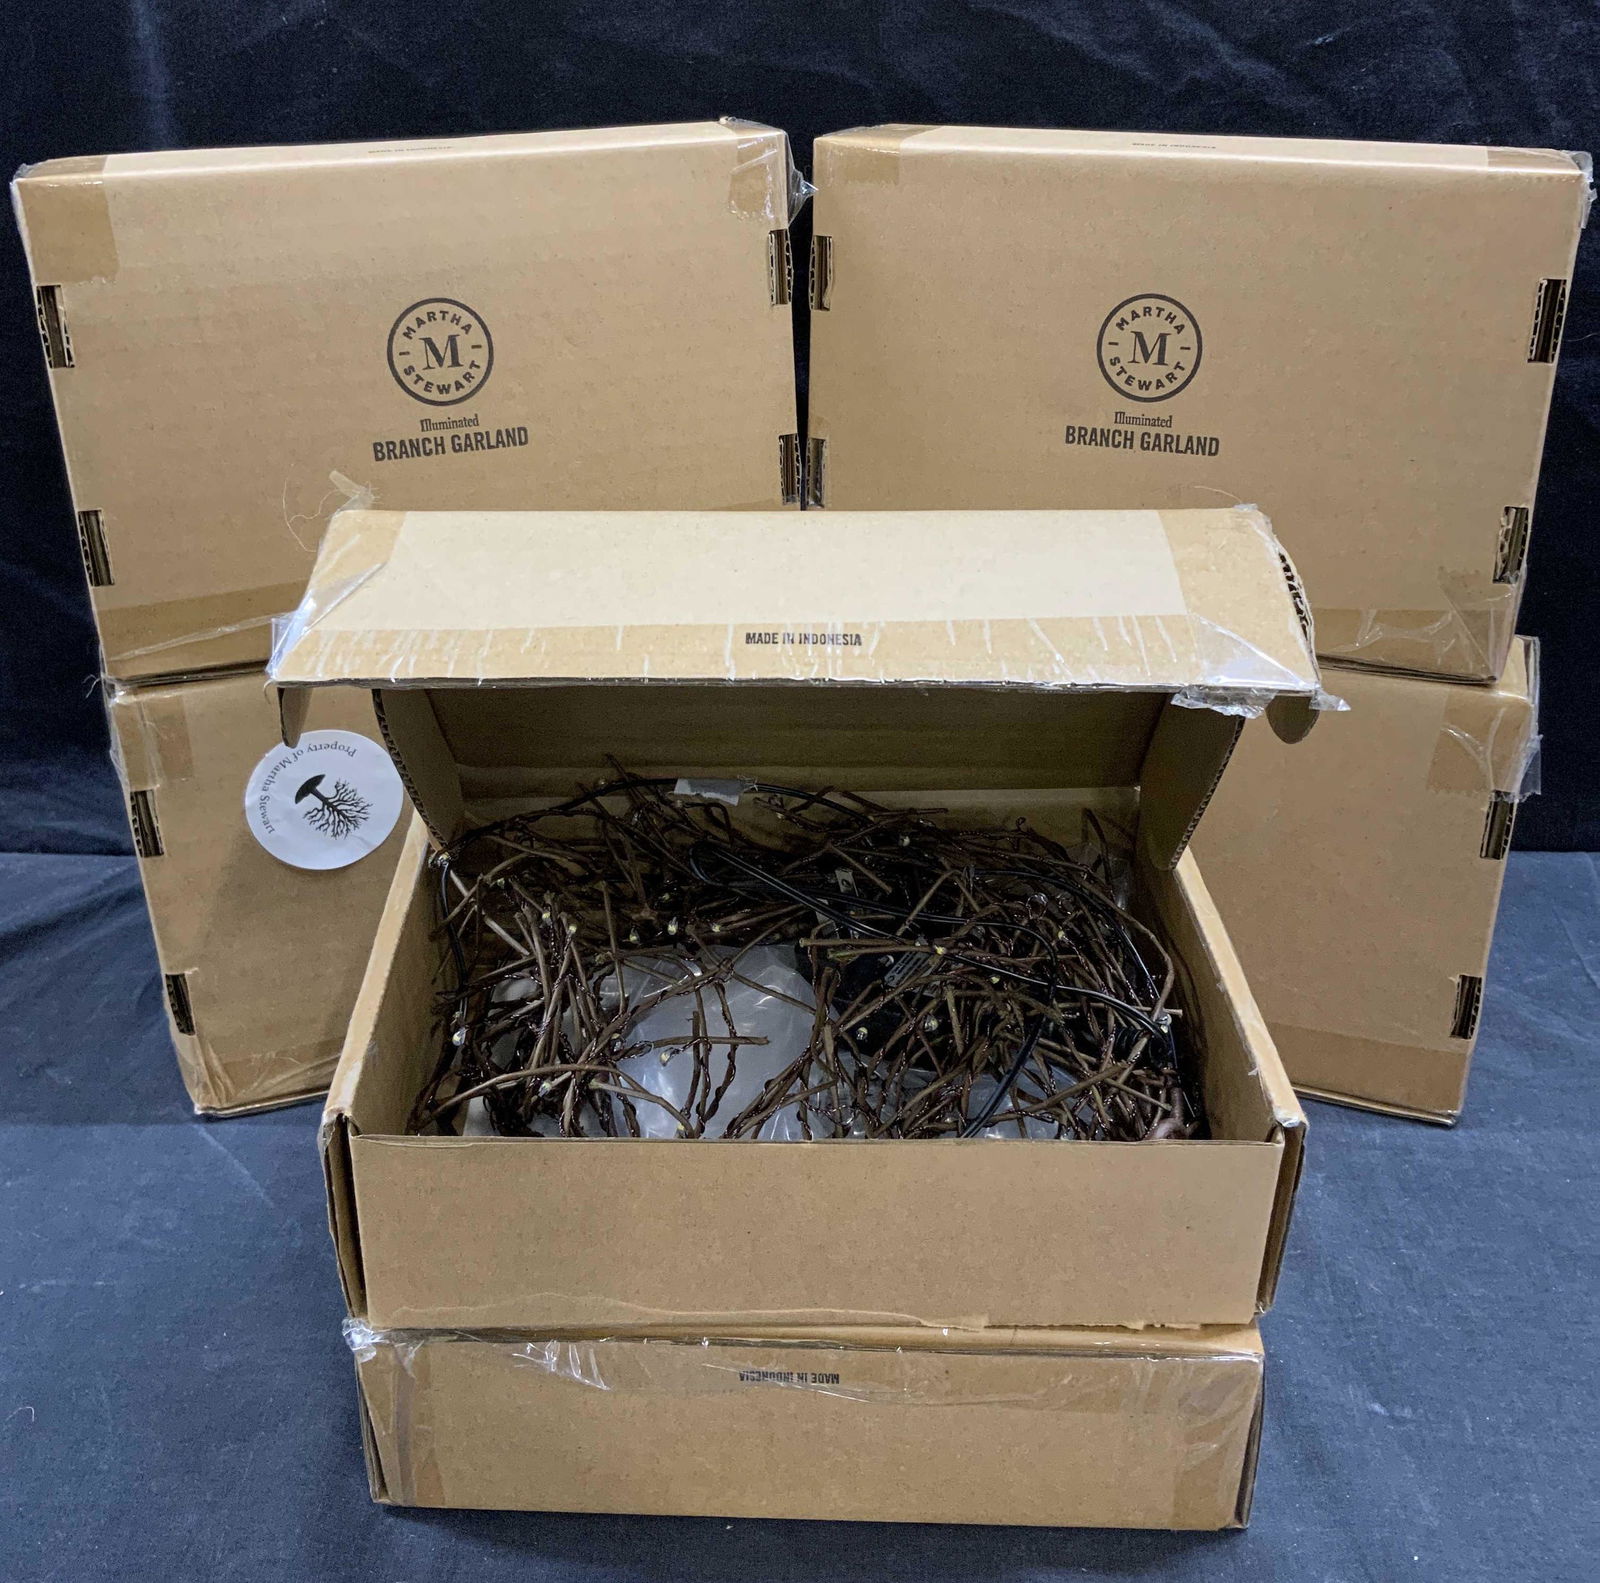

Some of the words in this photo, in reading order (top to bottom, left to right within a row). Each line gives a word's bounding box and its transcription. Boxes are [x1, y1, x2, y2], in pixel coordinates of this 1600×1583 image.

[402, 310, 473, 340] MARTHA
[1115, 306, 1186, 335] MARTHA
[418, 334, 464, 371] M
[1127, 330, 1172, 366] M
[403, 360, 481, 395] STEWART
[1109, 356, 1185, 391] STEWART
[420, 413, 480, 433] Illuminated
[1113, 411, 1173, 429] Illuminated
[372, 436, 447, 462] BRANCH
[450, 426, 529, 454] GARLAND
[1065, 425, 1135, 450] BRANCH
[1139, 431, 1220, 457] GARLAND
[745, 632, 779, 645] MADE
[782, 632, 795, 645] IN
[798, 633, 862, 646] INDONESIA
[292, 749, 305, 764] of
[306, 740, 358, 758] Property
[261, 755, 293, 793] Martha
[258, 794, 276, 834] Stewart
[739, 1370, 794, 1384] INDONESIA
[796, 1371, 808, 1383] IN
[810, 1372, 840, 1385] MADE
